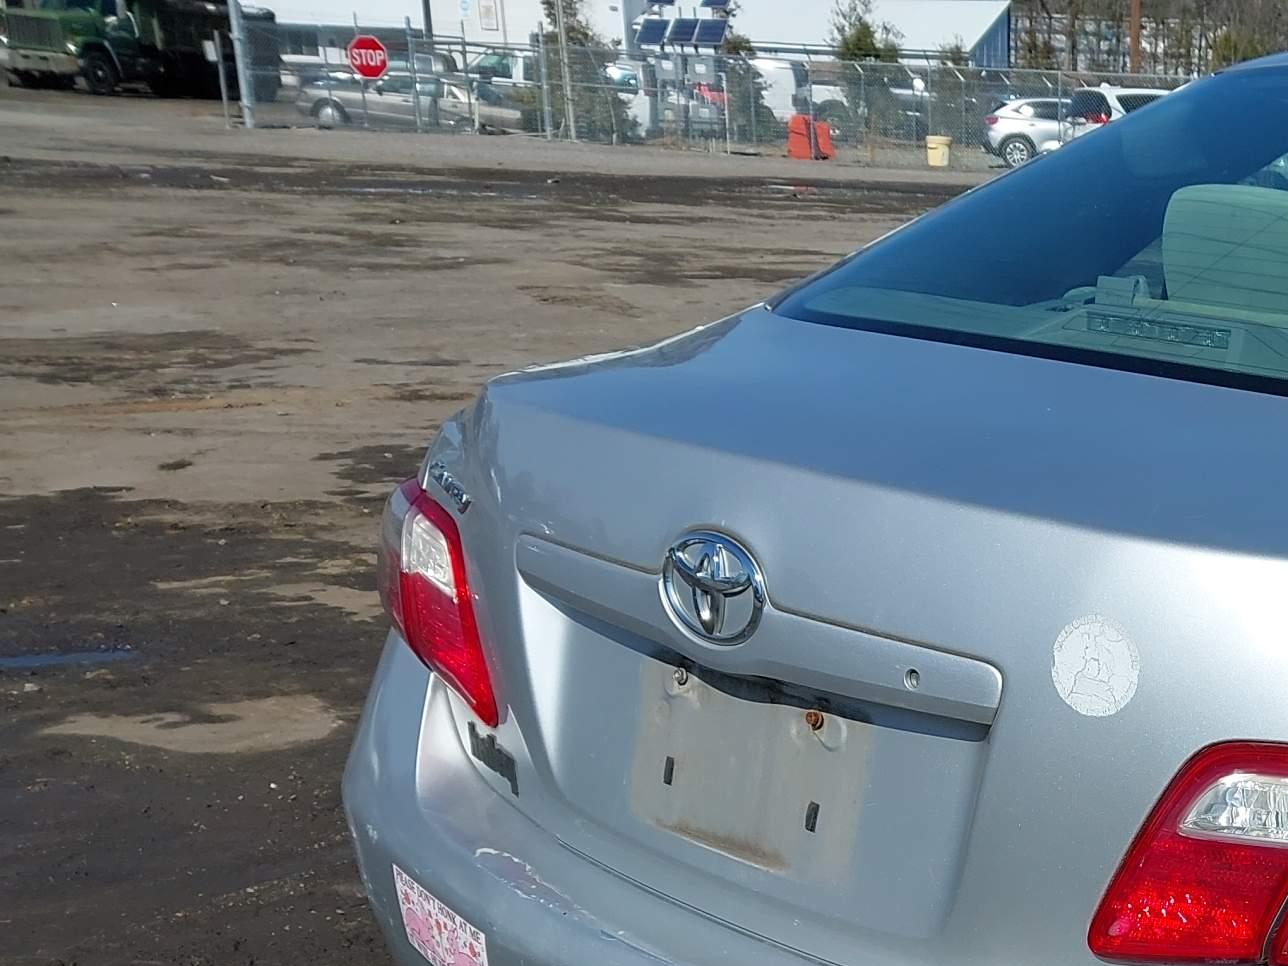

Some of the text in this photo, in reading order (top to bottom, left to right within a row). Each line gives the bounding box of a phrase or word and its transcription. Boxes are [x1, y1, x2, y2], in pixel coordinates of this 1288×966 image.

[351, 48, 385, 66] STOP
[394, 867, 417, 895] PLEASE
[436, 902, 458, 927] HONK
[458, 919, 469, 937] AT
[468, 925, 482, 946] ME
